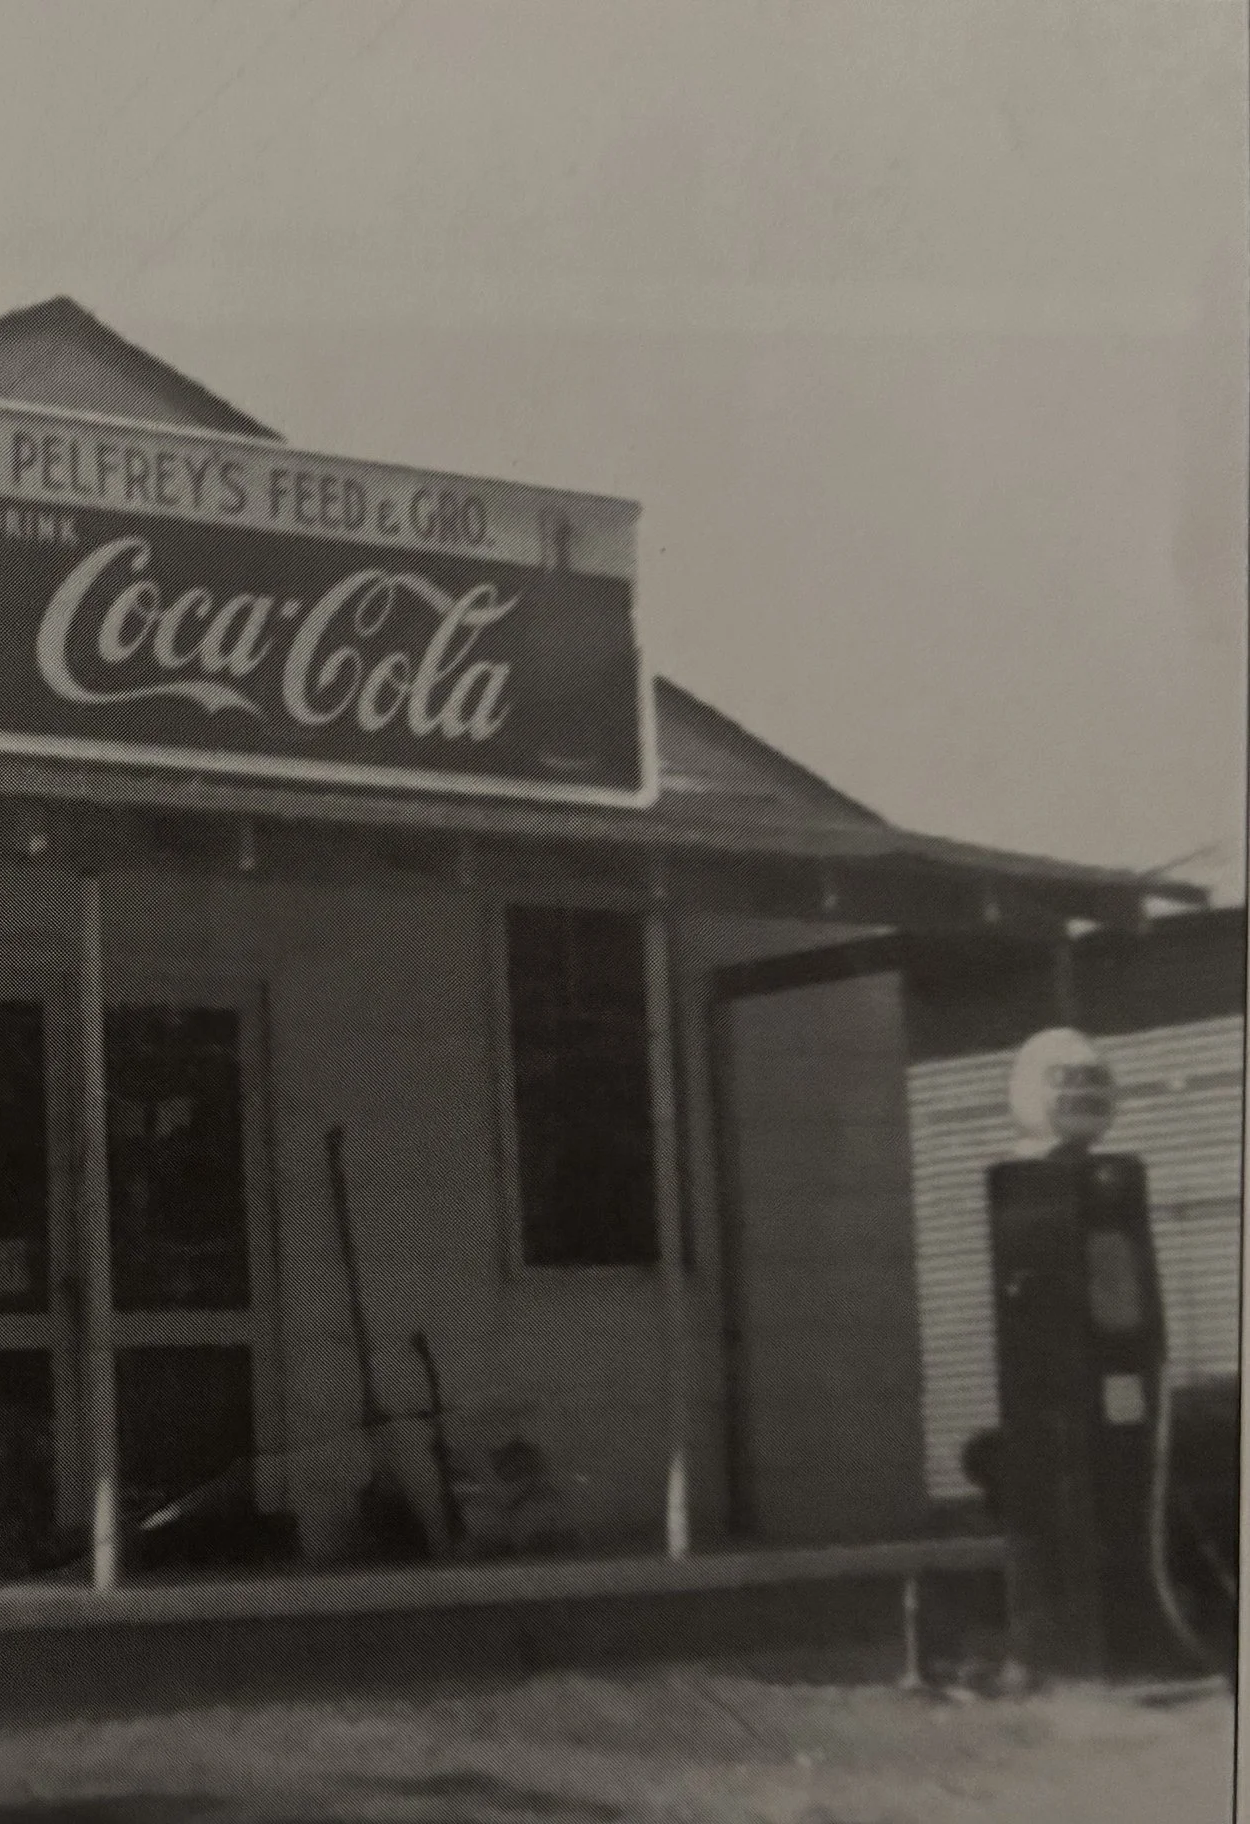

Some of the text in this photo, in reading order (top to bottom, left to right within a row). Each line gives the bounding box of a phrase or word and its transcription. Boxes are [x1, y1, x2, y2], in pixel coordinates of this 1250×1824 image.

[12, 430, 247, 513] PELFREY'S
[270, 469, 367, 528] FEED
[409, 486, 493, 547] GRO.
[36, 537, 520, 743] Coca-Cola
